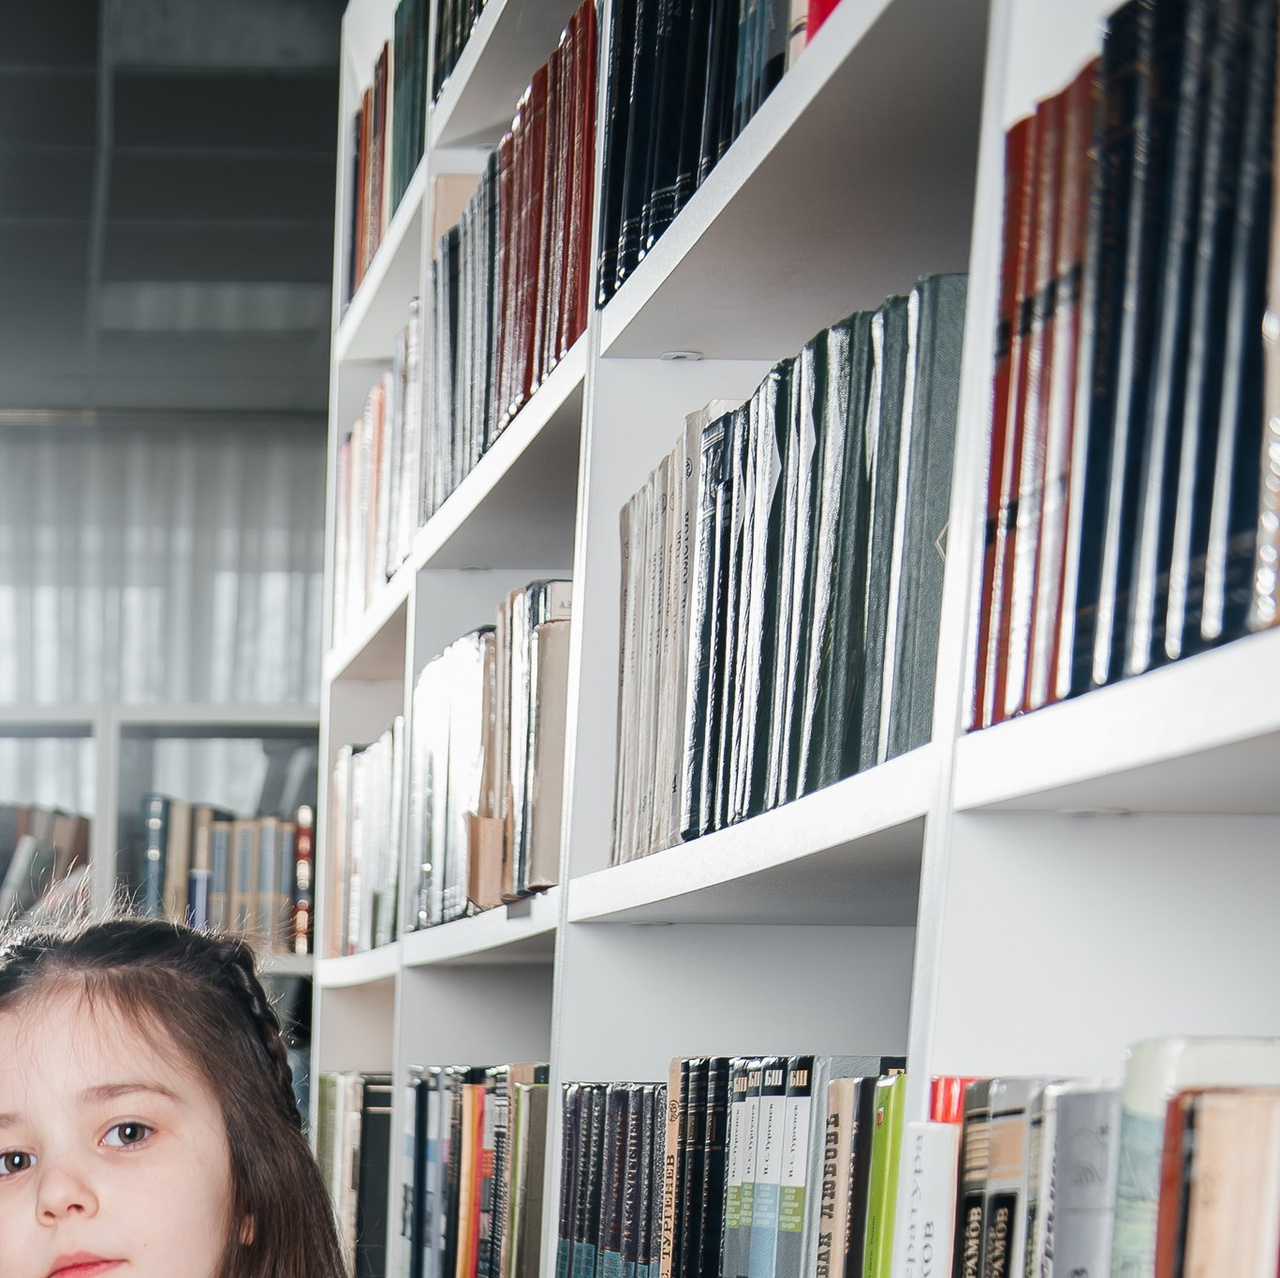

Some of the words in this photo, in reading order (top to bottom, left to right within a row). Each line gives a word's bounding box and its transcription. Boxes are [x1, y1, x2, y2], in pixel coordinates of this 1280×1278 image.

[764, 1069, 784, 1087] БШ
[789, 1069, 809, 1087] БШ
[818, 1112, 839, 1220] ЛЮБОВЬ
[661, 1154, 676, 1259] ТУРГЕНЕВ
